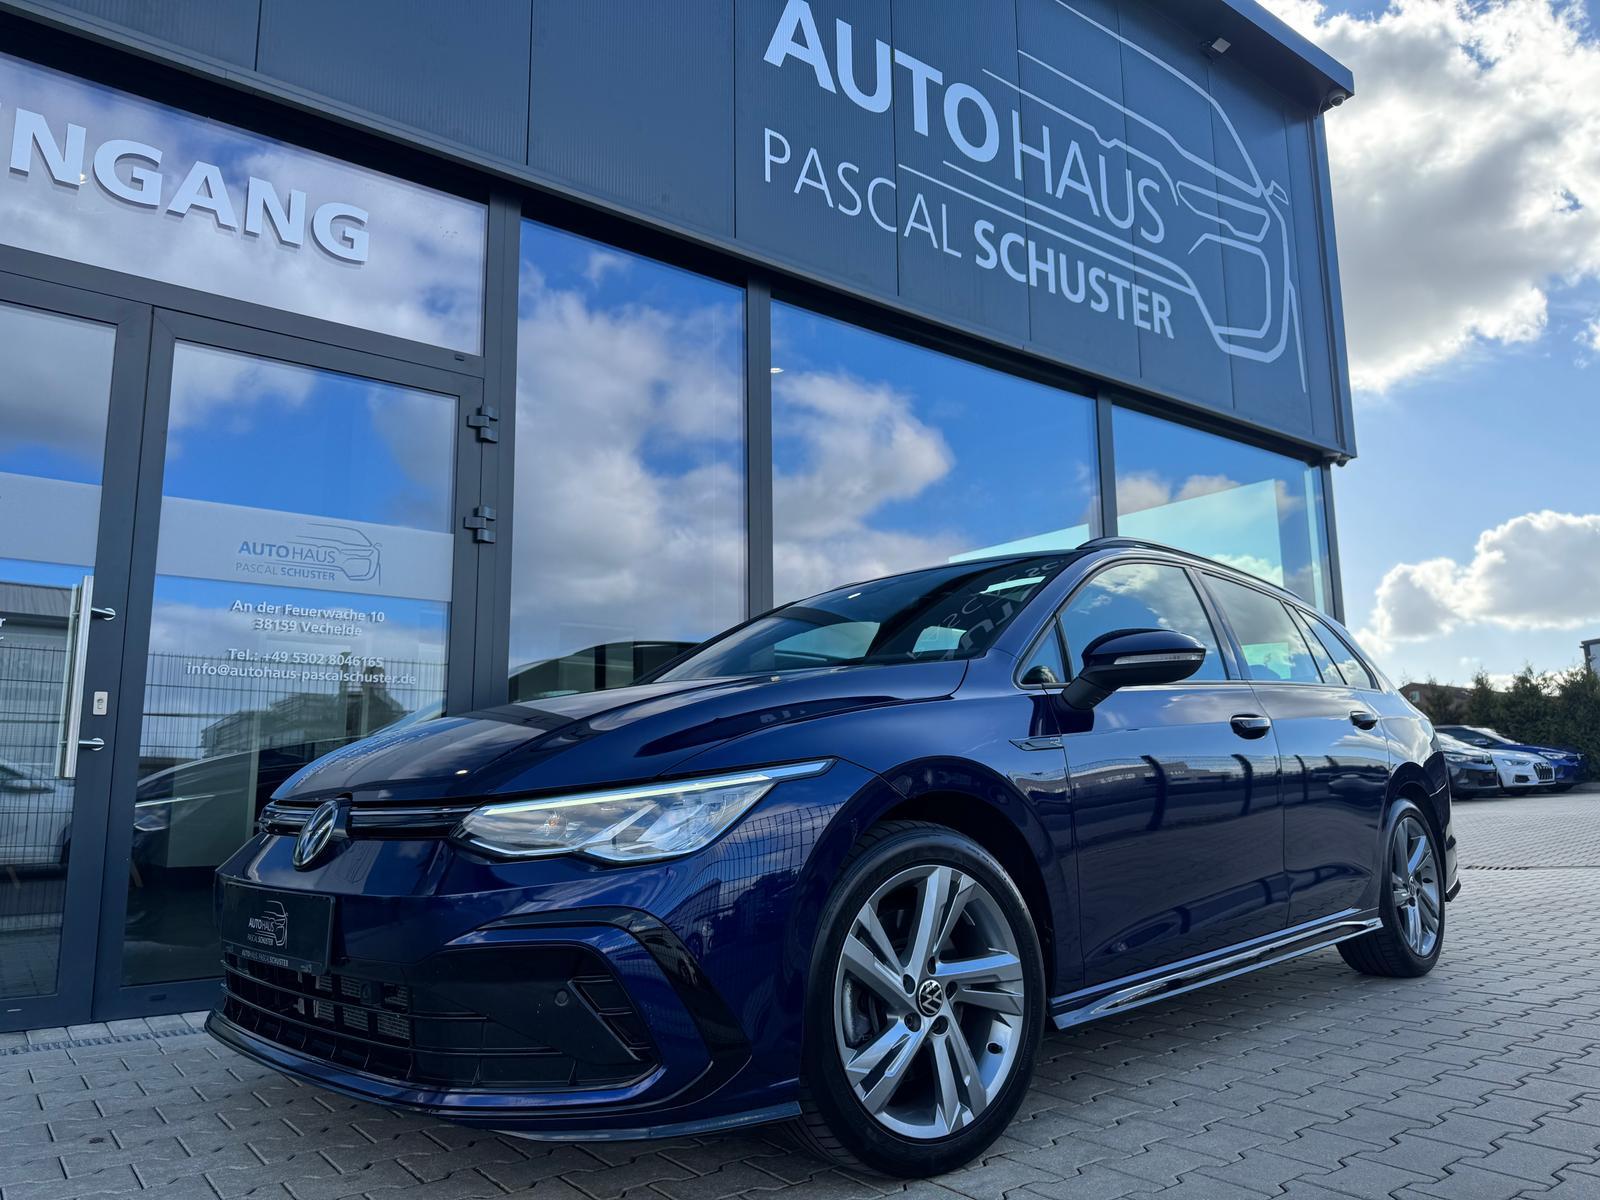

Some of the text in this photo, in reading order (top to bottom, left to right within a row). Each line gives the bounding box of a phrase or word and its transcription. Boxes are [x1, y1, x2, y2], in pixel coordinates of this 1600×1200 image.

[0, 103, 370, 264] NGANG
[764, 127, 1175, 340] PASCAL SCHUSTER
[235, 562, 336, 582] PASCAL SCHUSTER
[231, 599, 385, 624] An der Feuerwache 10
[255, 618, 362, 637] 38159 Vechelde
[228, 648, 384, 669] Tel.: +49 5302 8046165
[187, 662, 417, 686] info@autohaus-pascalschuster.de
